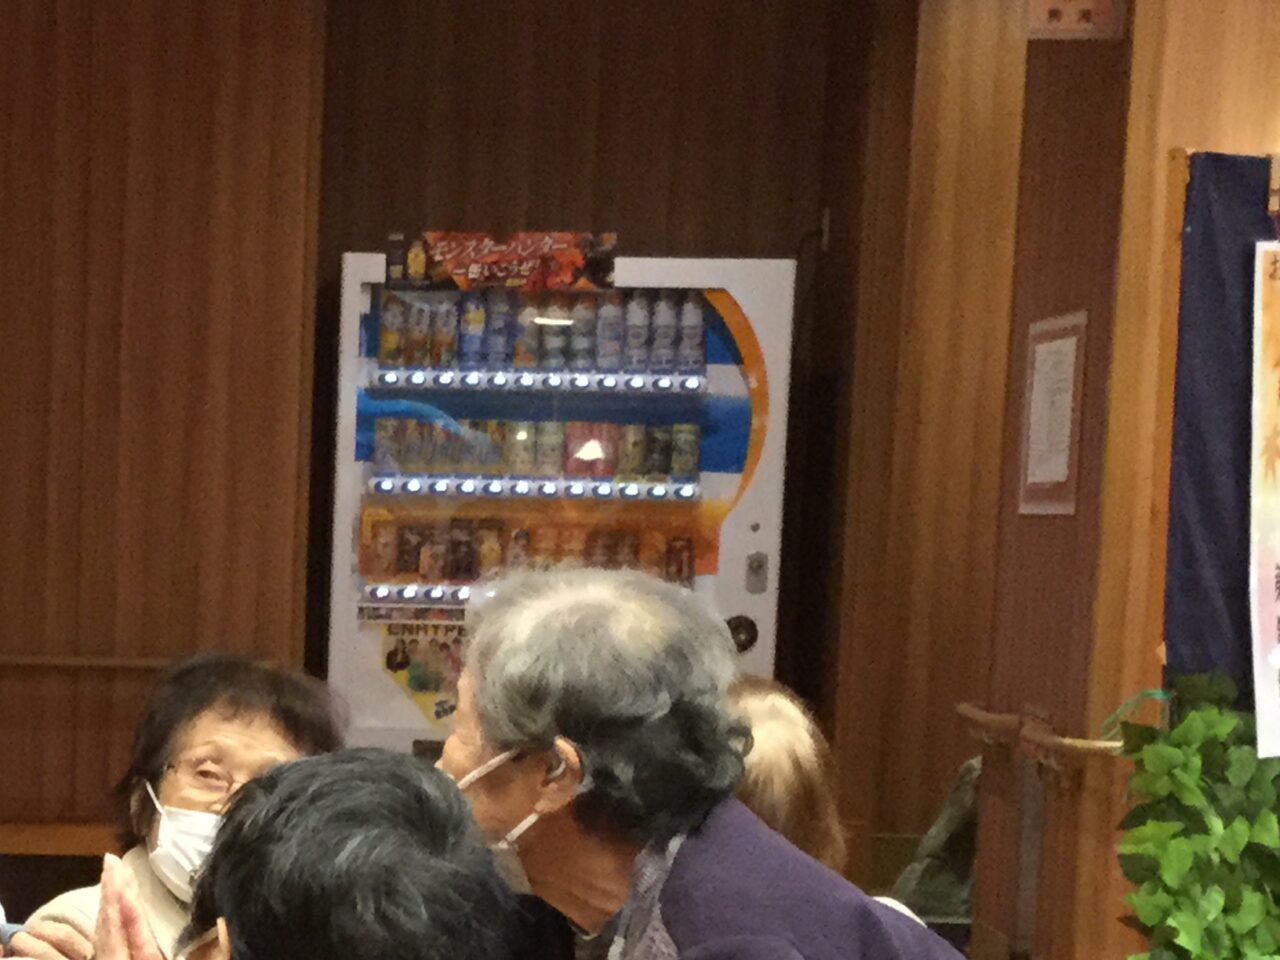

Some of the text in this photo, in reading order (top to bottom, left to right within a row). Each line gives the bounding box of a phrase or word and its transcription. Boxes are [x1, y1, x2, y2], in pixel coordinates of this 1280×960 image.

[430, 236, 568, 261] モンスターハンター
